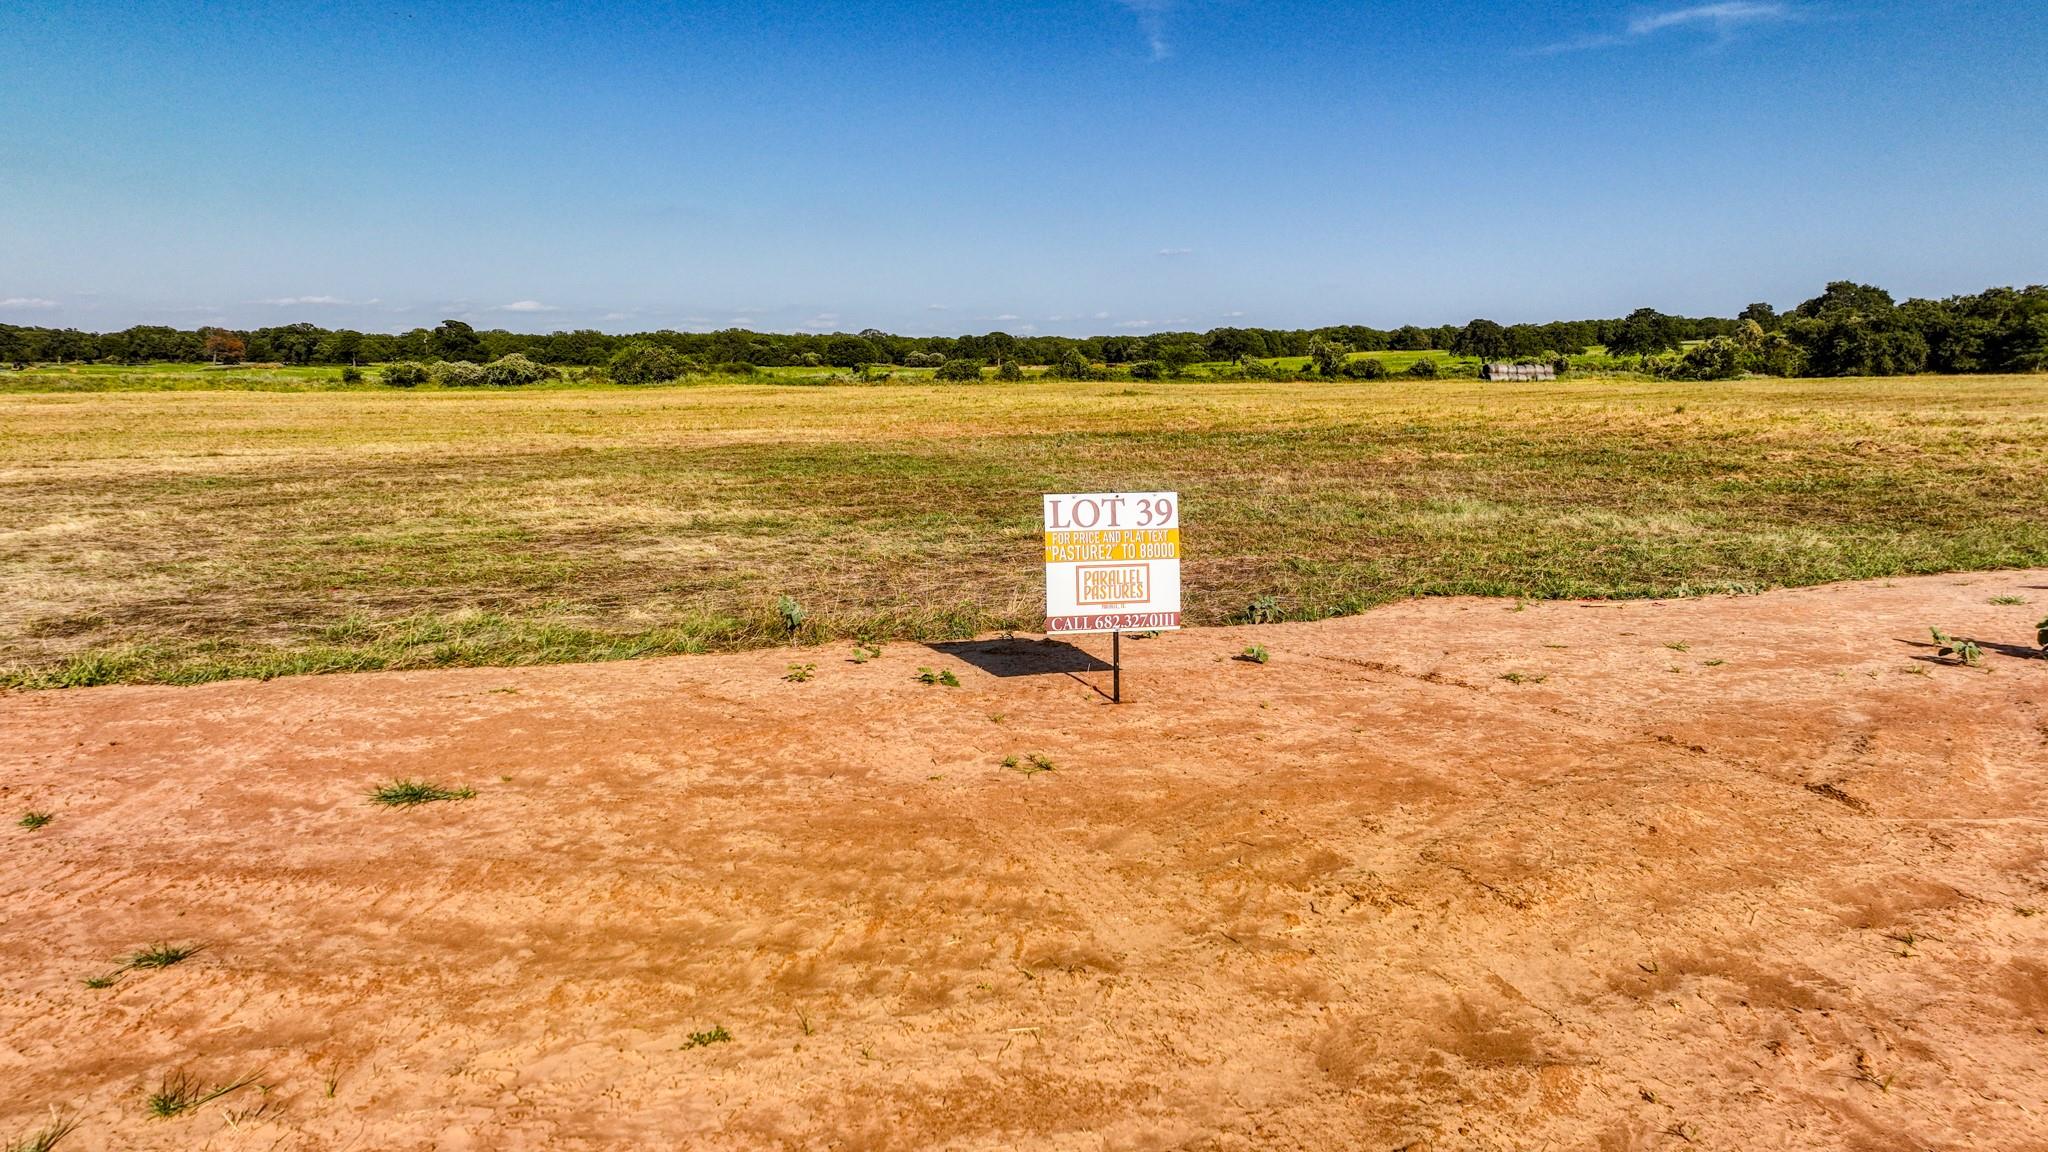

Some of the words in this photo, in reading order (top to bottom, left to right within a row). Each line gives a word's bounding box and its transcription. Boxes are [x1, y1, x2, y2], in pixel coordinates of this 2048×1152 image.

[1048, 498, 1125, 528] LOT
[1136, 498, 1173, 527] 39
[1052, 532, 1071, 545] FOR
[1073, 531, 1100, 544] PRICE
[1103, 530, 1121, 543] AND
[1124, 530, 1146, 543] PLAT
[1147, 529, 1169, 542] TEXT
[1122, 543, 1136, 559] TO
[1140, 542, 1175, 558] 88000
[1083, 568, 1142, 586] PARALLEL
[1084, 582, 1143, 600] PASTURES
[1051, 616, 1093, 631] CALL
[1095, 612, 1176, 629] 682.327.0111
